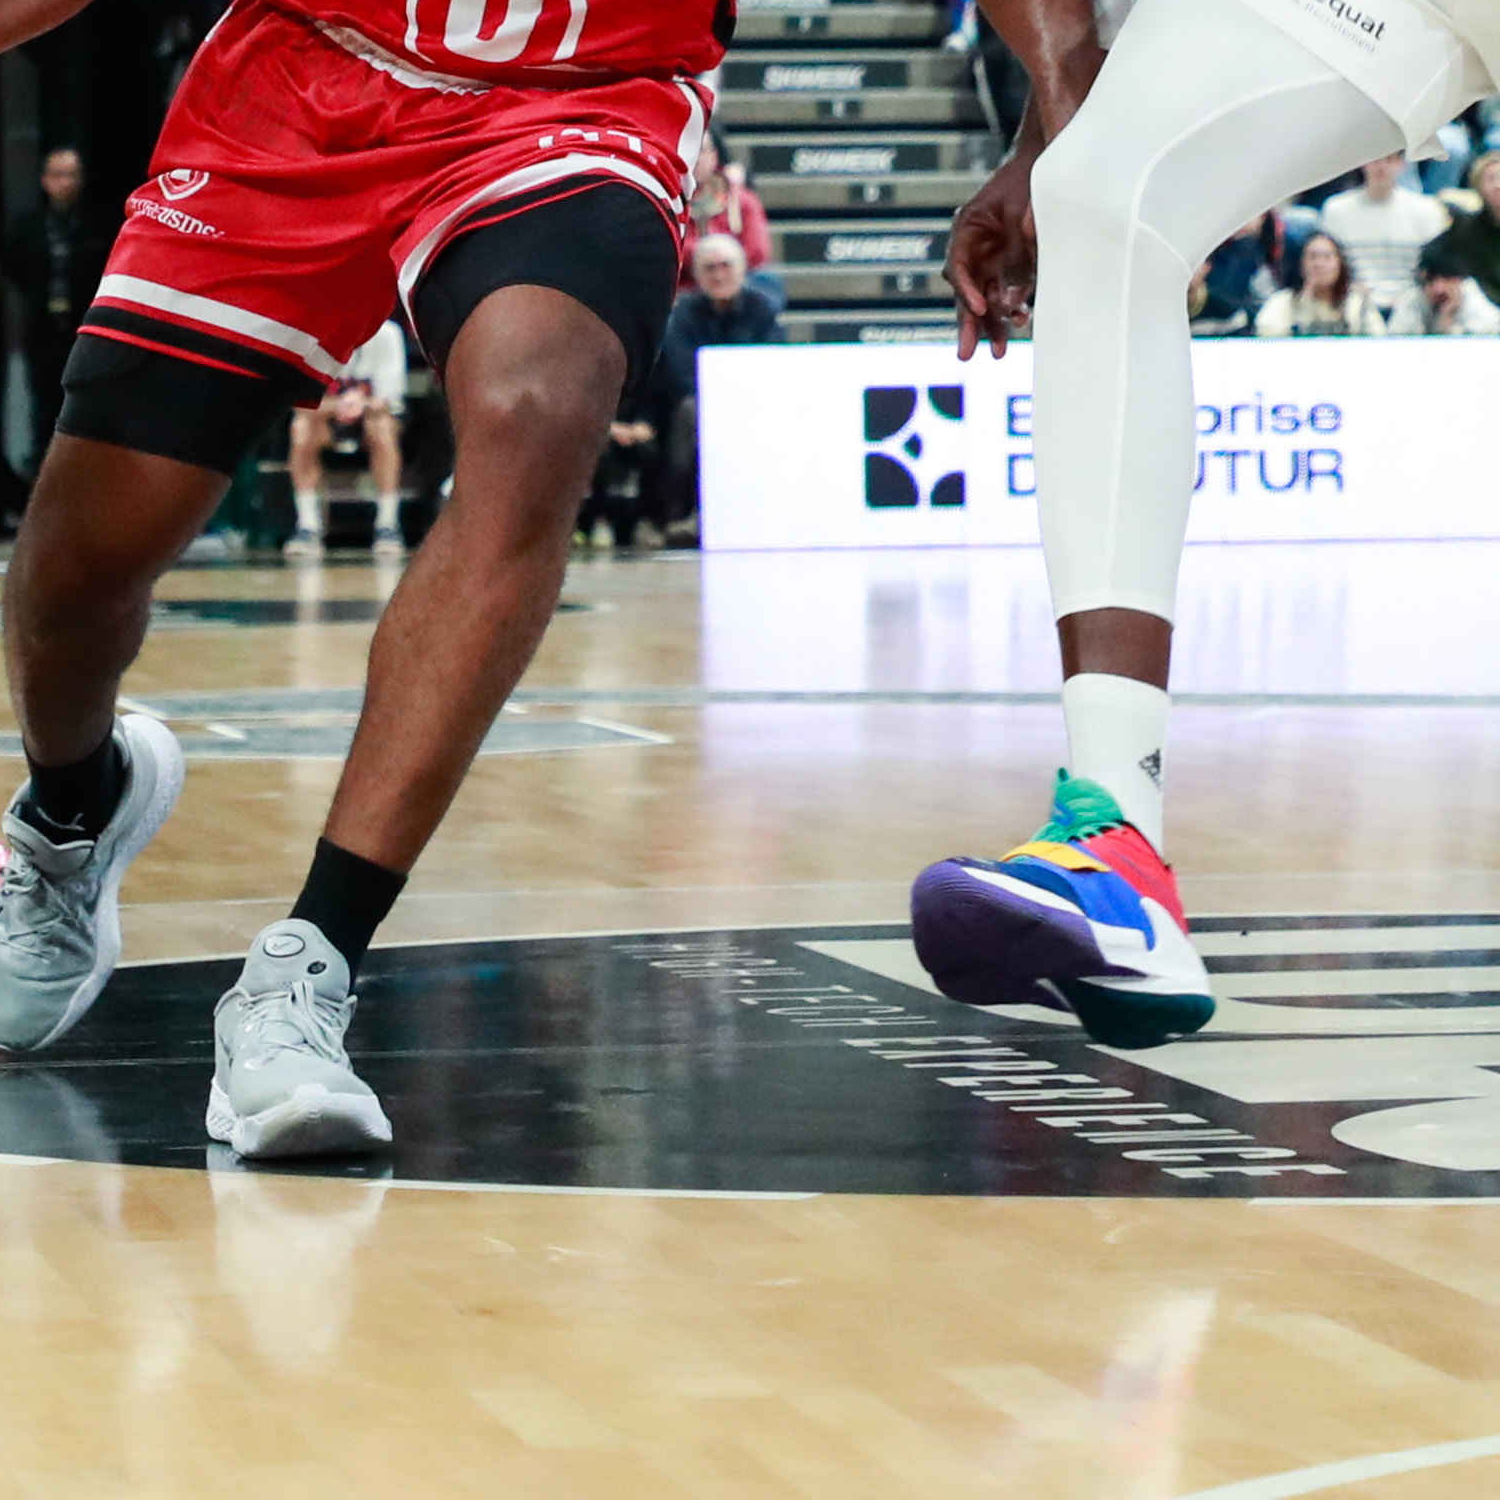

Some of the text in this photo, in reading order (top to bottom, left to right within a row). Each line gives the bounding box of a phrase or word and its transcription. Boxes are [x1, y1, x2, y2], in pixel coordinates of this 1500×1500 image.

[763, 64, 867, 91] SKWEEK
[791, 147, 898, 174] SKWEEK
[825, 234, 933, 262] SKWEEK
[1007, 391, 1344, 442] Eprise
[841, 1034, 1347, 1180] EXPERIENCE
